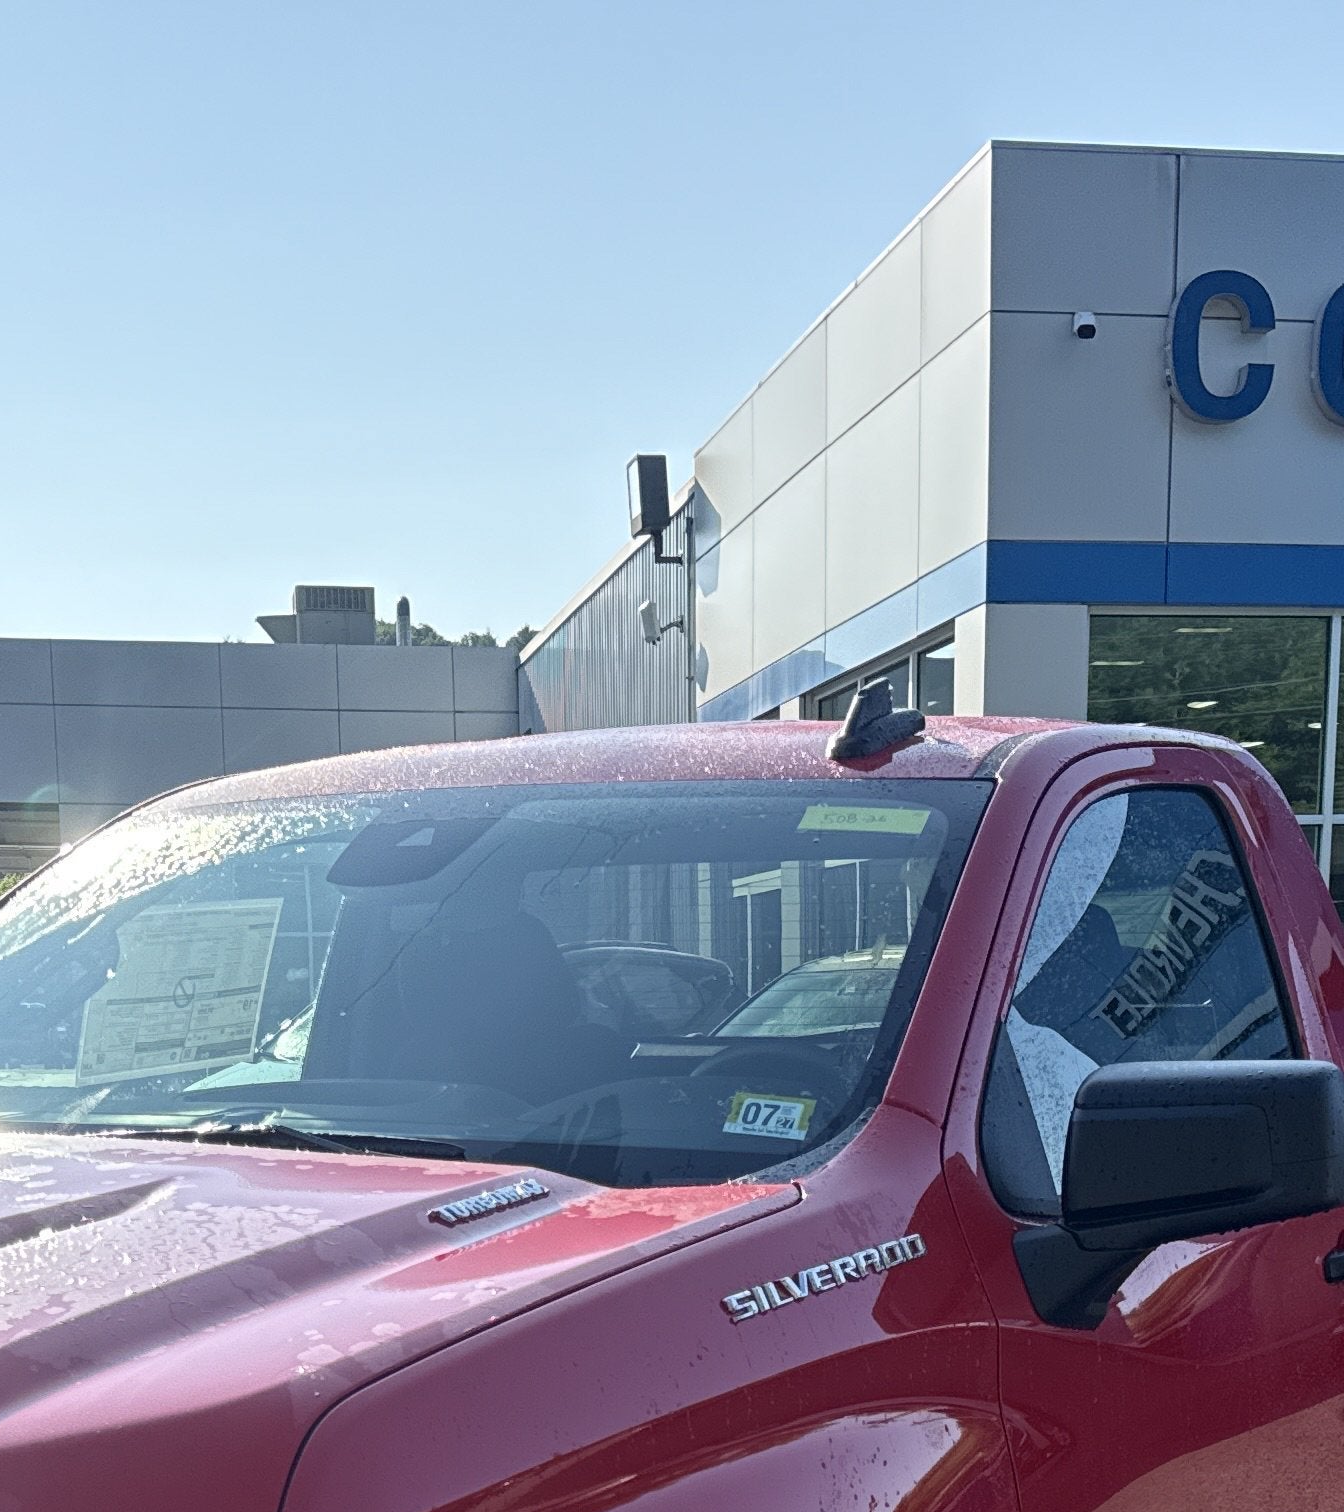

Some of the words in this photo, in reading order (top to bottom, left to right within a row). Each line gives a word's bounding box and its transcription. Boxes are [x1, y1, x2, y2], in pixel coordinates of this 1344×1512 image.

[742, 1102, 782, 1126] 07
[775, 1116, 796, 1129] 27
[721, 1232, 927, 1324] SILVERADO
